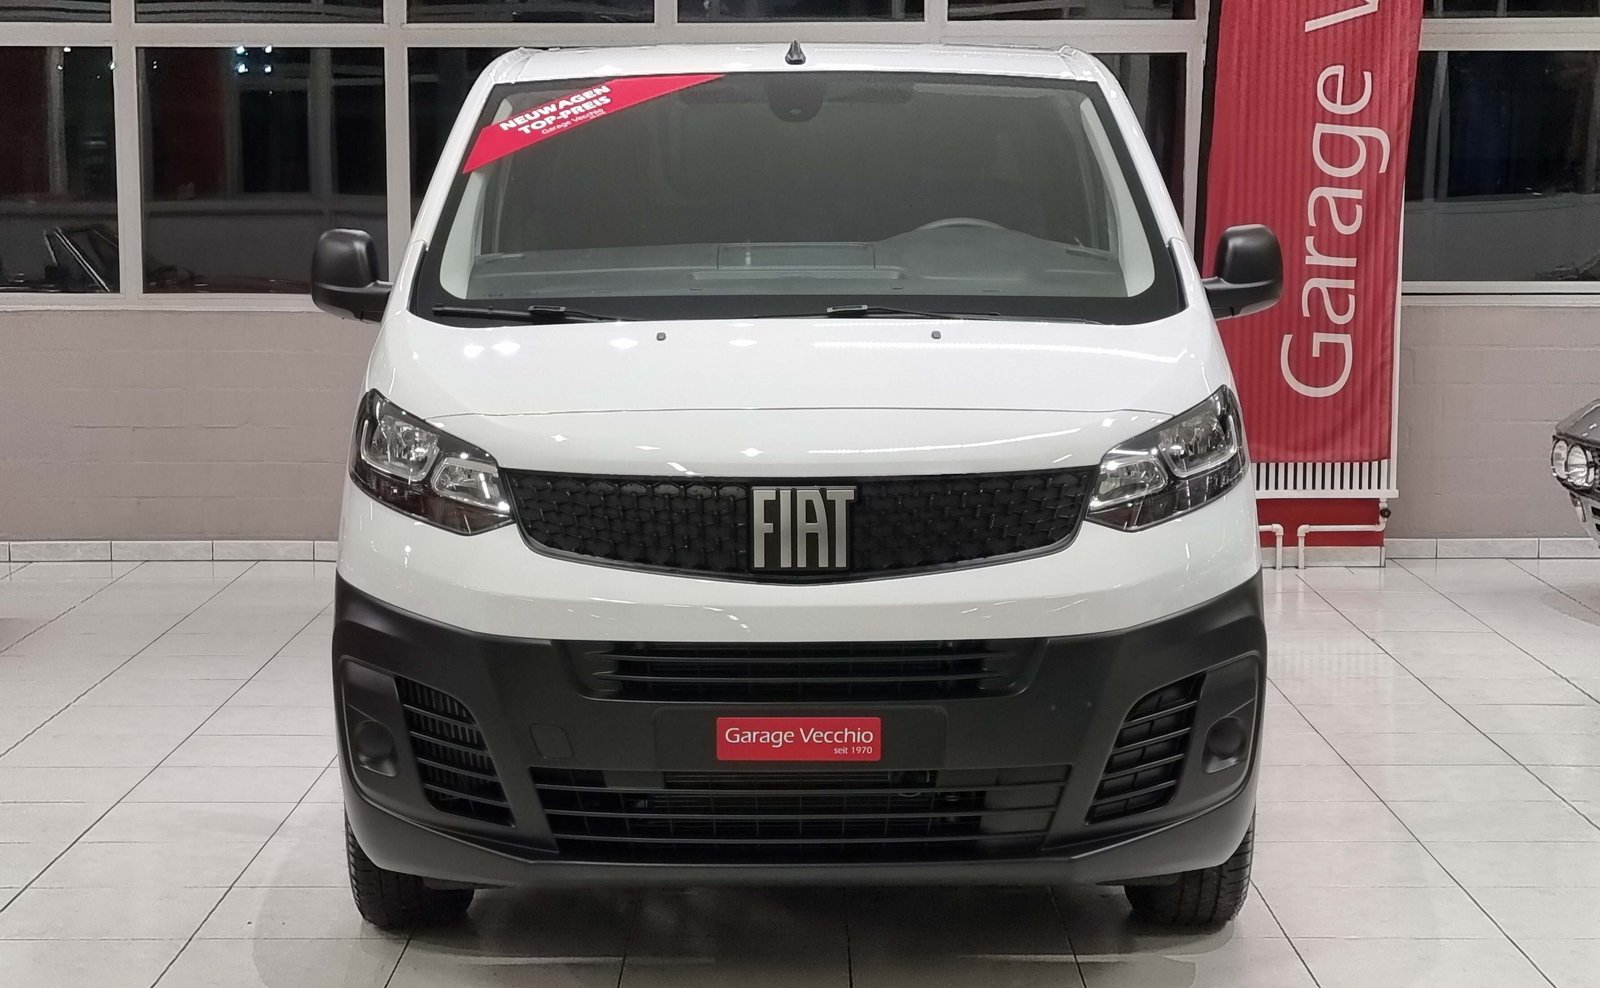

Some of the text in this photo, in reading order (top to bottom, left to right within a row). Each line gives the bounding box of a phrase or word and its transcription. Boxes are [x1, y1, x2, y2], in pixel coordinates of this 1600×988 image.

[499, 85, 611, 131] NEUWAGEN
[517, 95, 611, 134] TOP-PREIS
[541, 120, 571, 134] Garage
[1280, 64, 1391, 398] Garage
[752, 487, 855, 568] FIAT
[725, 727, 874, 748] Garage Vecchio
[834, 746, 873, 755] seit 1970
